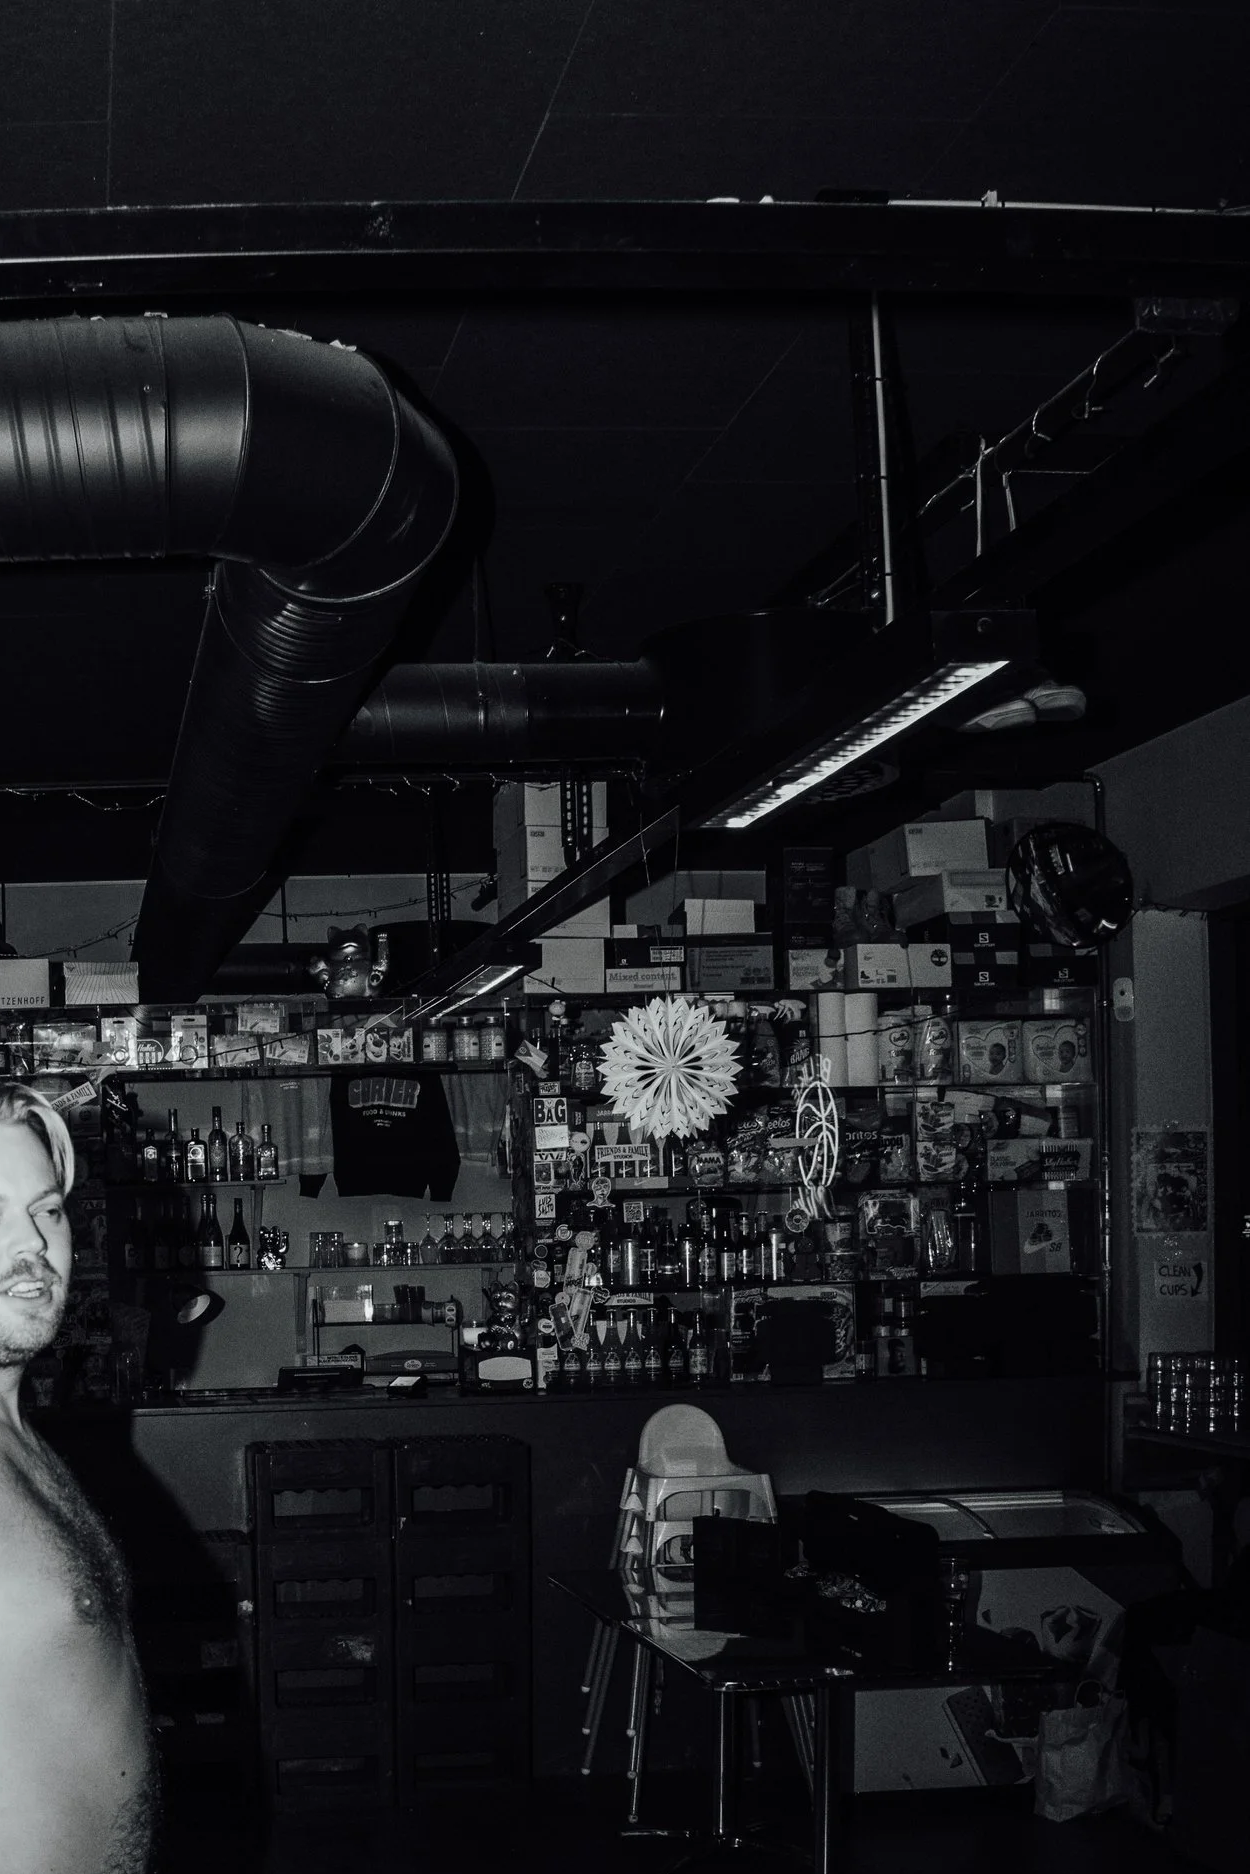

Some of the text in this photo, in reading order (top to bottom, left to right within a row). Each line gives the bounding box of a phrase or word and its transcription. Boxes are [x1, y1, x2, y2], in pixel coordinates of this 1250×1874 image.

[71, 1086, 93, 1100] FAMILY
[766, 1117, 791, 1130] eetos
[846, 1130, 878, 1141] oritos
[597, 1147, 622, 1159] FRIENDS
[628, 1146, 648, 1157] FAMILY
[1158, 1265, 1191, 1277] CLEAN
[1159, 1284, 1188, 1296] CUPS
